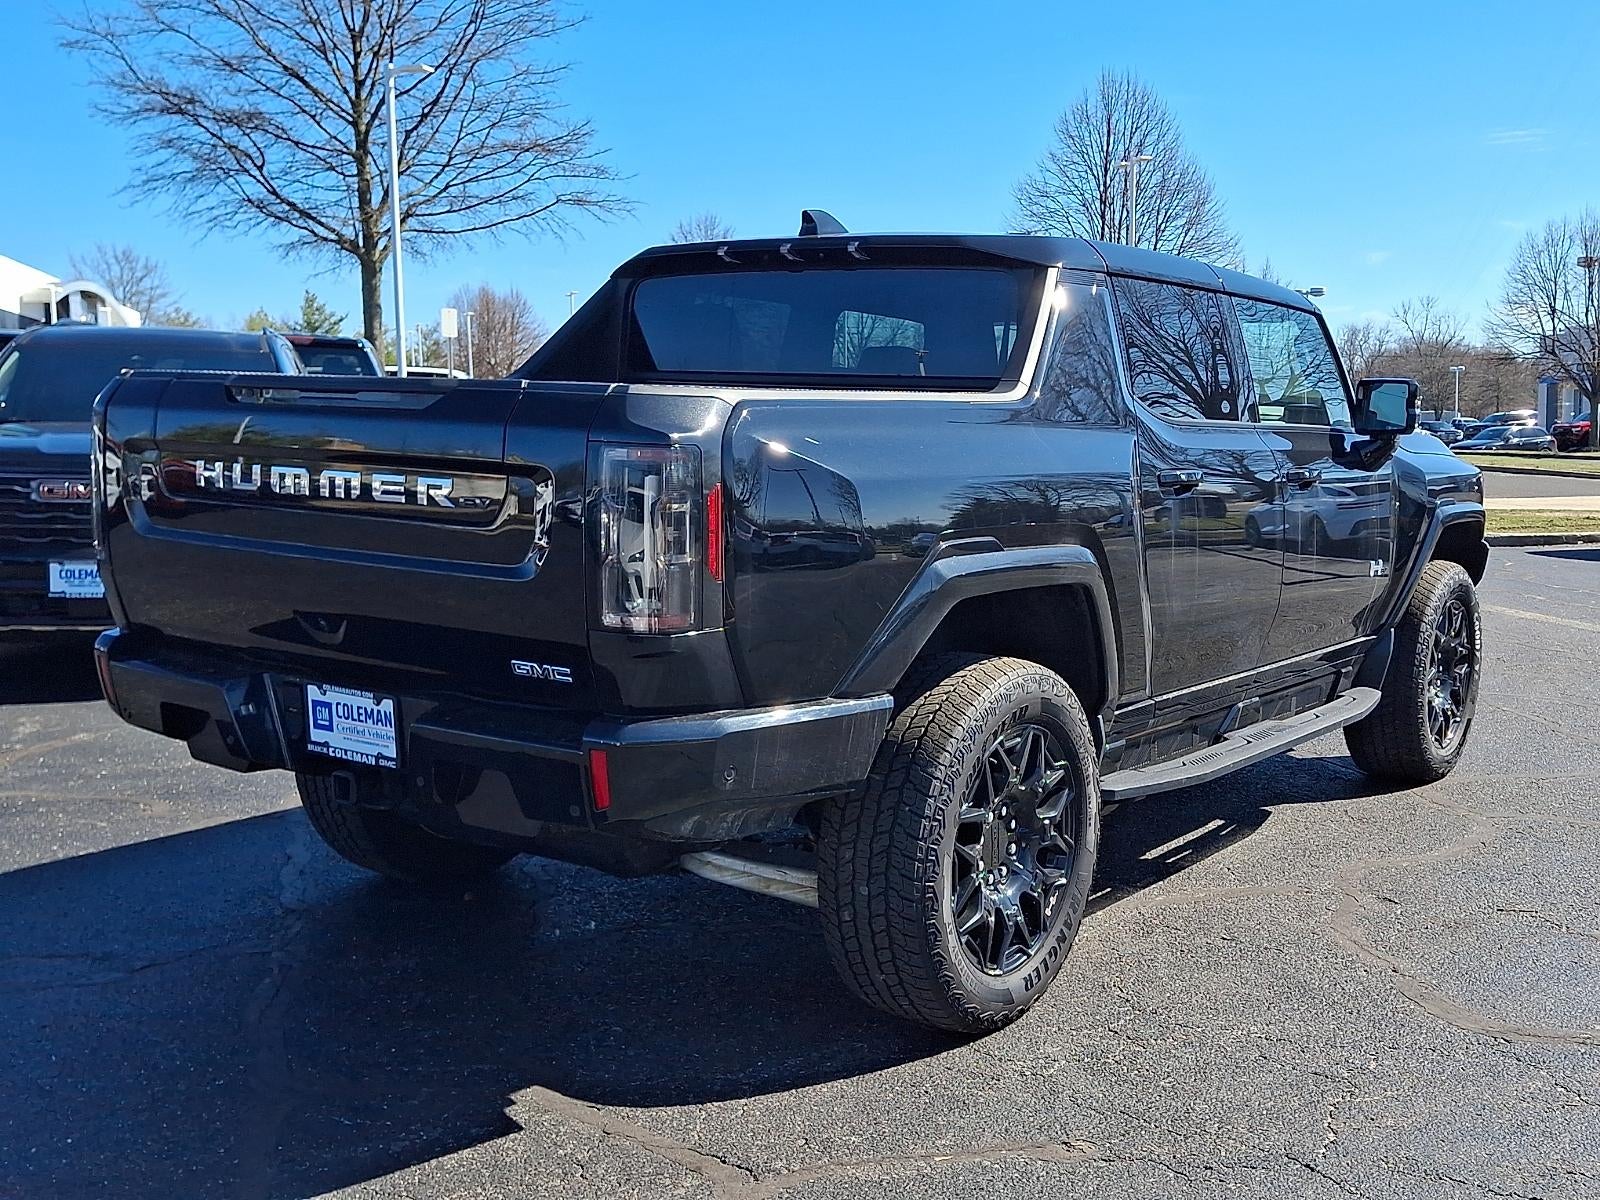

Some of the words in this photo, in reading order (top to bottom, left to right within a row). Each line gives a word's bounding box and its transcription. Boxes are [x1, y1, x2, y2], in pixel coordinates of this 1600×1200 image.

[40, 482, 92, 499] GM
[195, 459, 455, 508] HUMMER
[59, 569, 102, 580] COLEMA
[511, 660, 572, 682] GMC
[316, 705, 330, 721] GM
[335, 701, 393, 729] COLEMAN
[336, 723, 366, 737] Certified
[367, 730, 395, 742] Vehicles
[329, 747, 376, 766] COLEMAN
[378, 759, 397, 769] GMC
[1023, 872, 1087, 993] WRANGLER
